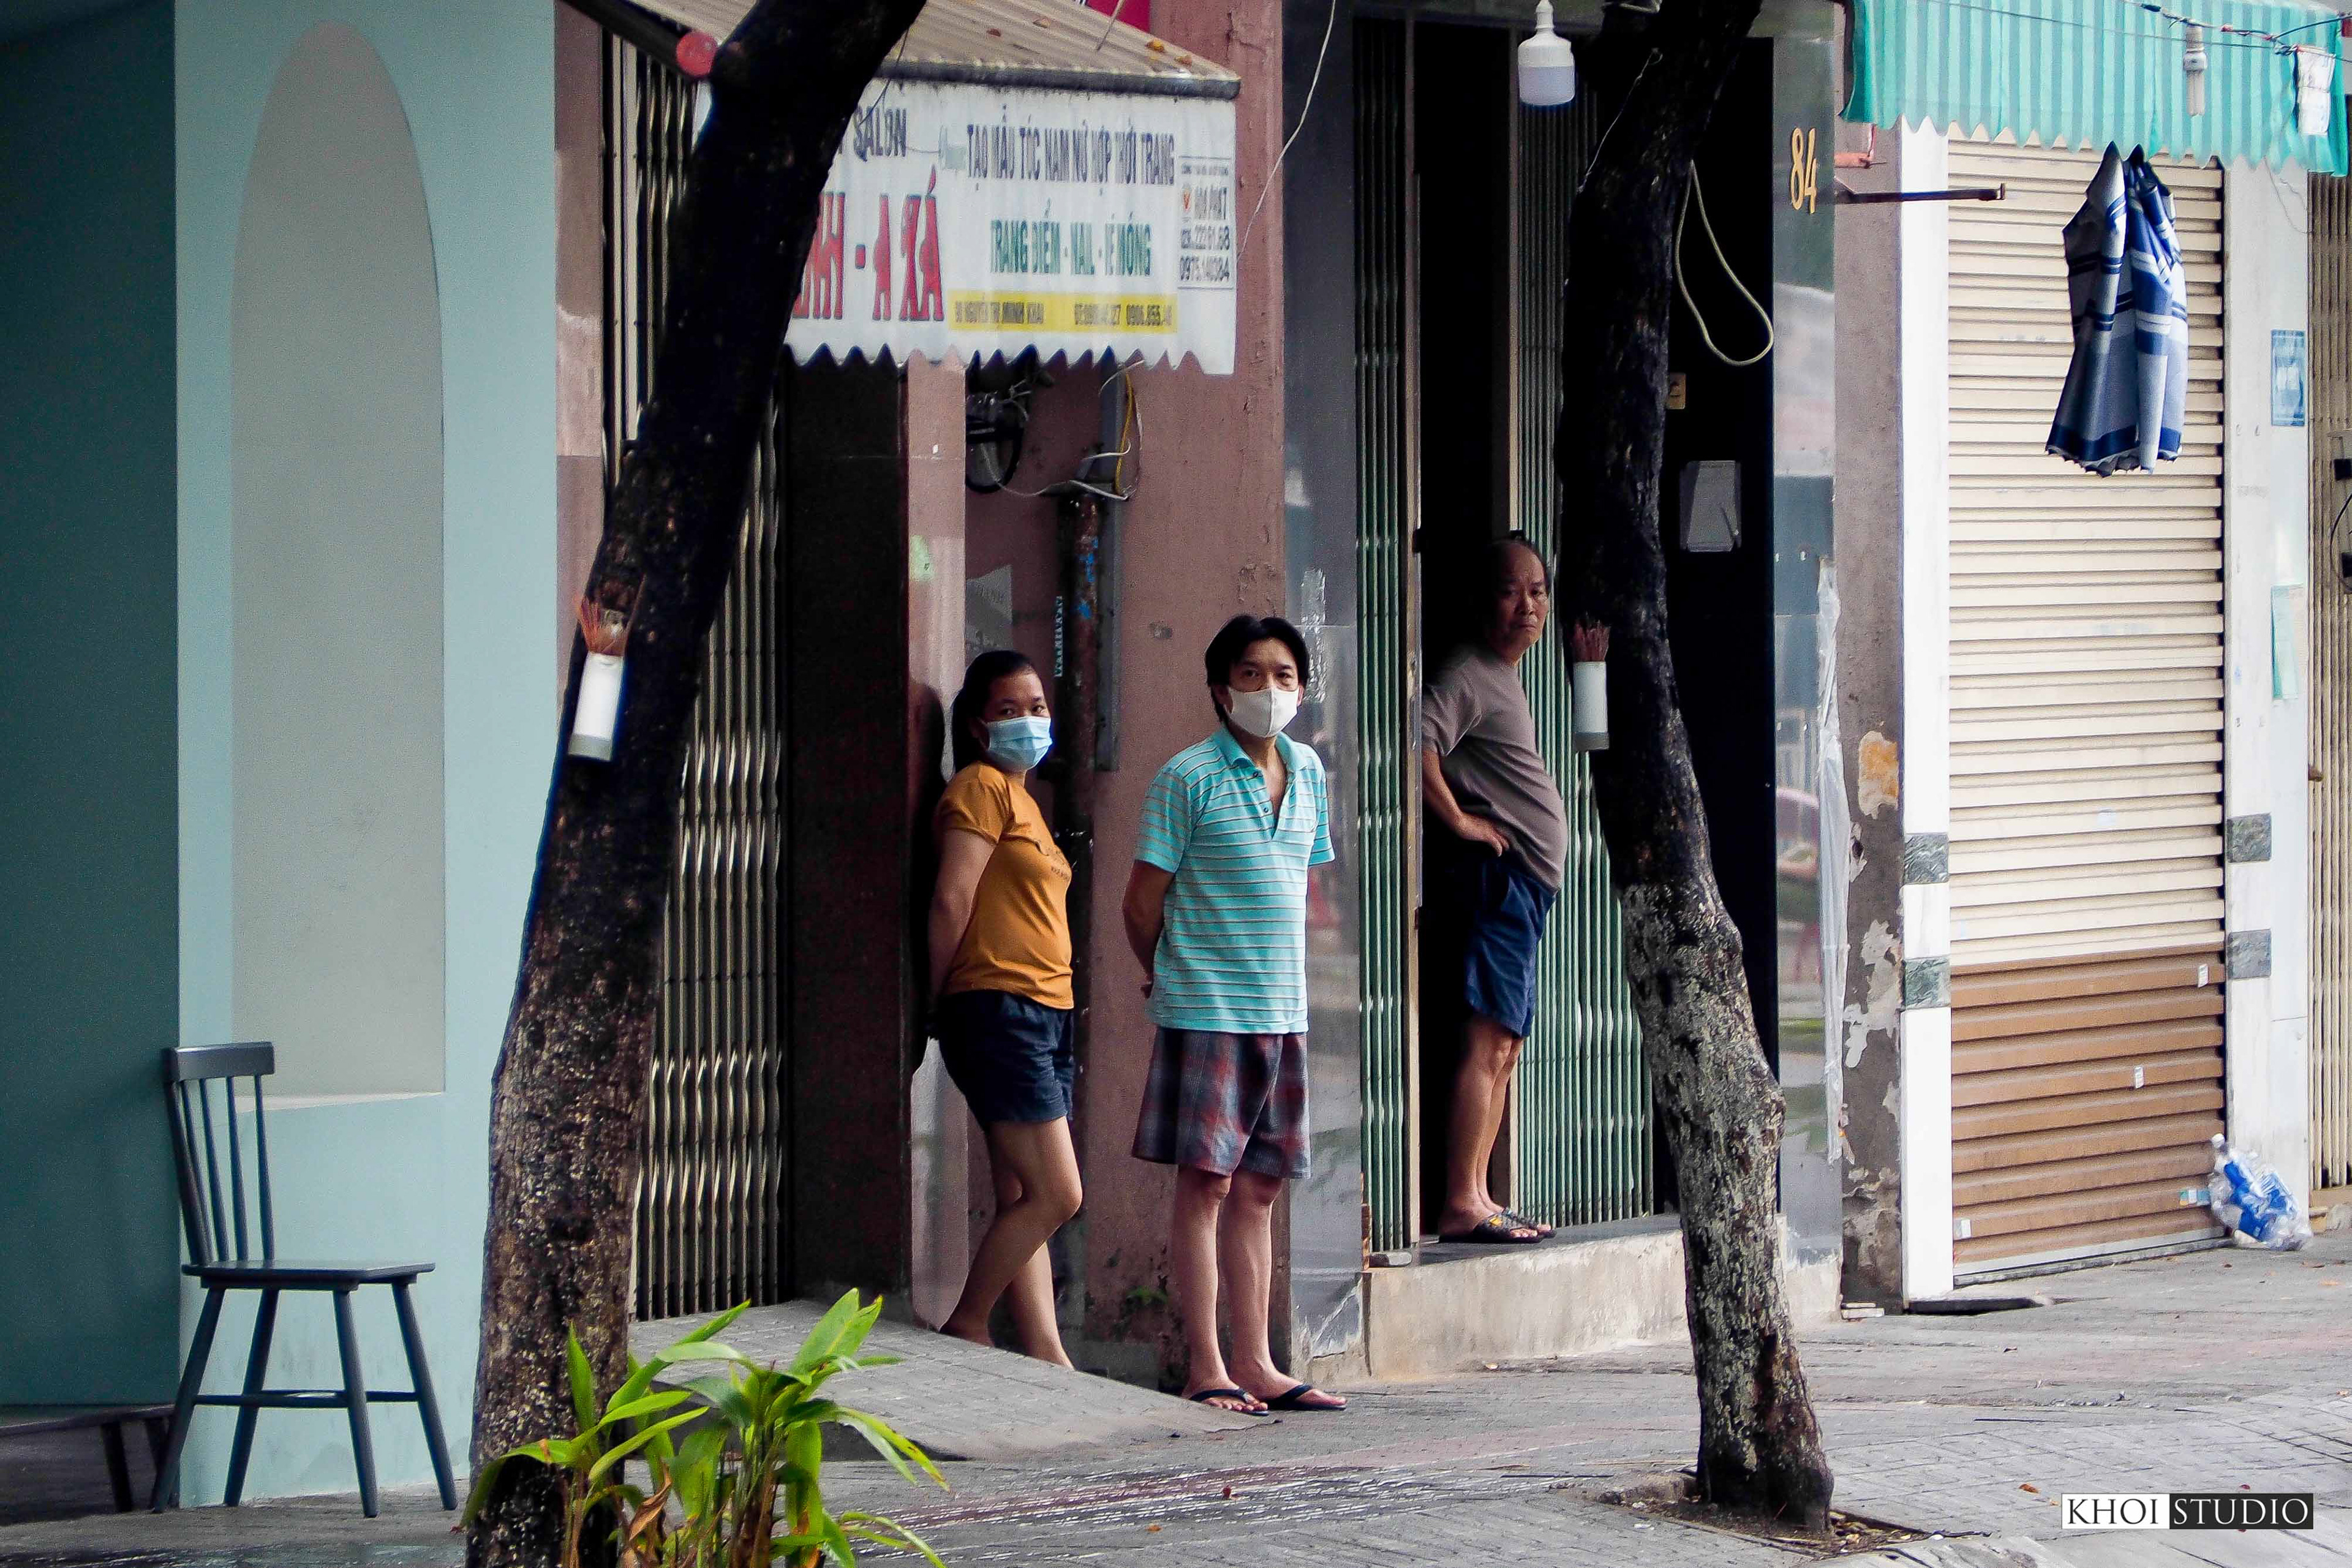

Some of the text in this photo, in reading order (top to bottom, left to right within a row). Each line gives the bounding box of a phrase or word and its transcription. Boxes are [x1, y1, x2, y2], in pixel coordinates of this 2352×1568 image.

[1019, 113, 1040, 180] TÓC
[1140, 130, 1174, 184] TRANG
[1791, 127, 1818, 214] 84
